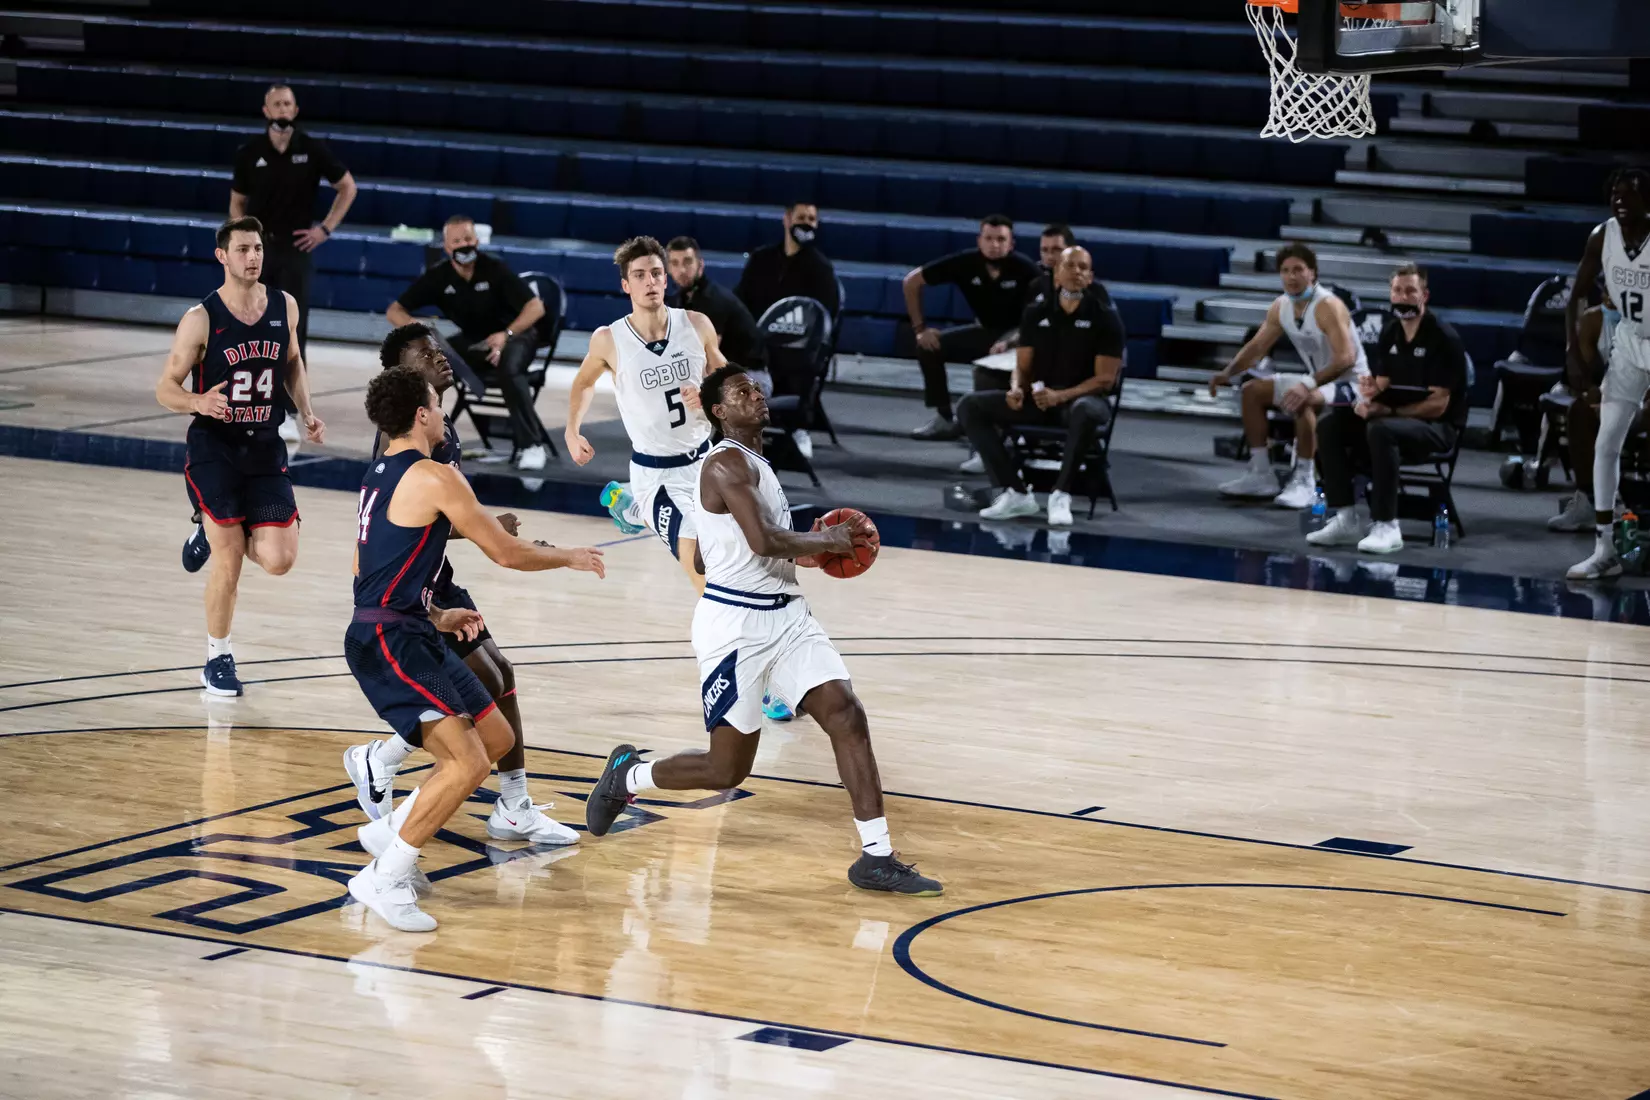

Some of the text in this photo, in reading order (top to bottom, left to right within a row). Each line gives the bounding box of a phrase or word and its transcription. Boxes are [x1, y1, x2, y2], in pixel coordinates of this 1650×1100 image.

[1620, 290, 1644, 323] 12
[223, 340, 281, 366] DIXIE
[230, 367, 275, 402] 24
[640, 358, 691, 390] CBU
[664, 387, 687, 429] 5
